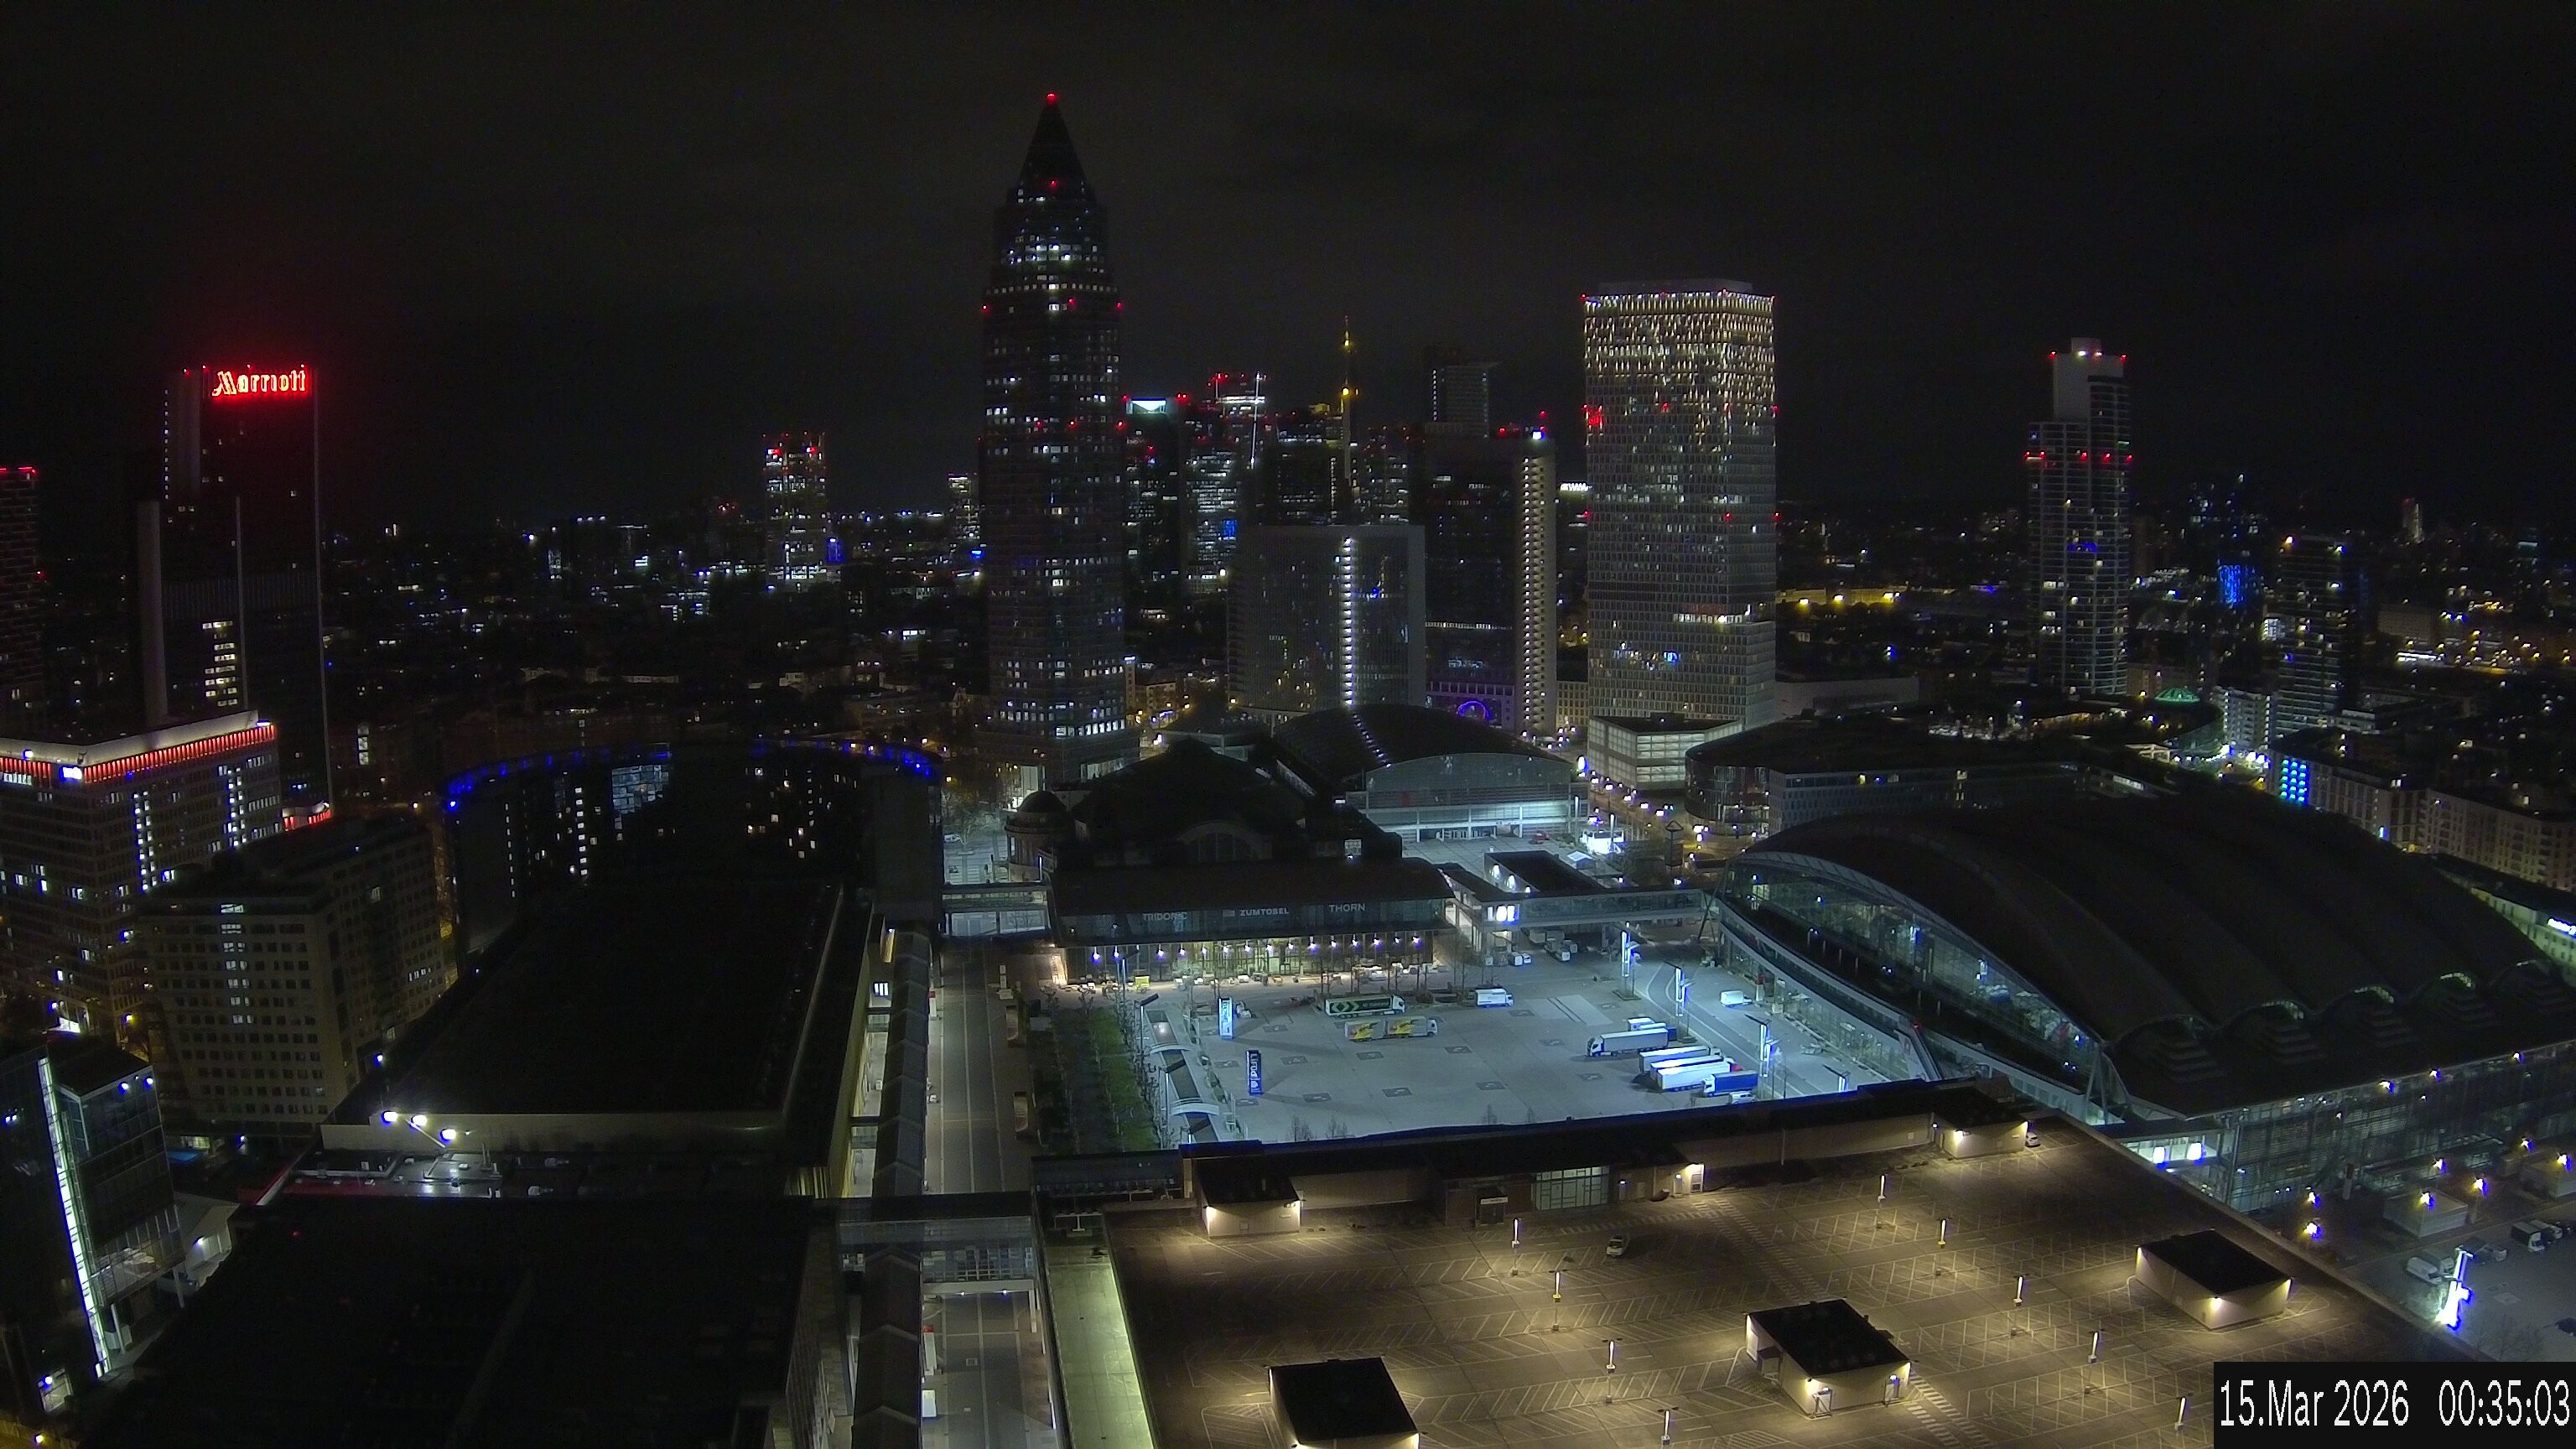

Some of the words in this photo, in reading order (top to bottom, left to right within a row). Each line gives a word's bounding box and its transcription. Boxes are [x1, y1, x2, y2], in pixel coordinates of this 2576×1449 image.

[211, 370, 306, 397] Marriott
[1239, 907, 1290, 917] ZUMTOBEL
[1328, 903, 1365, 913] THORN
